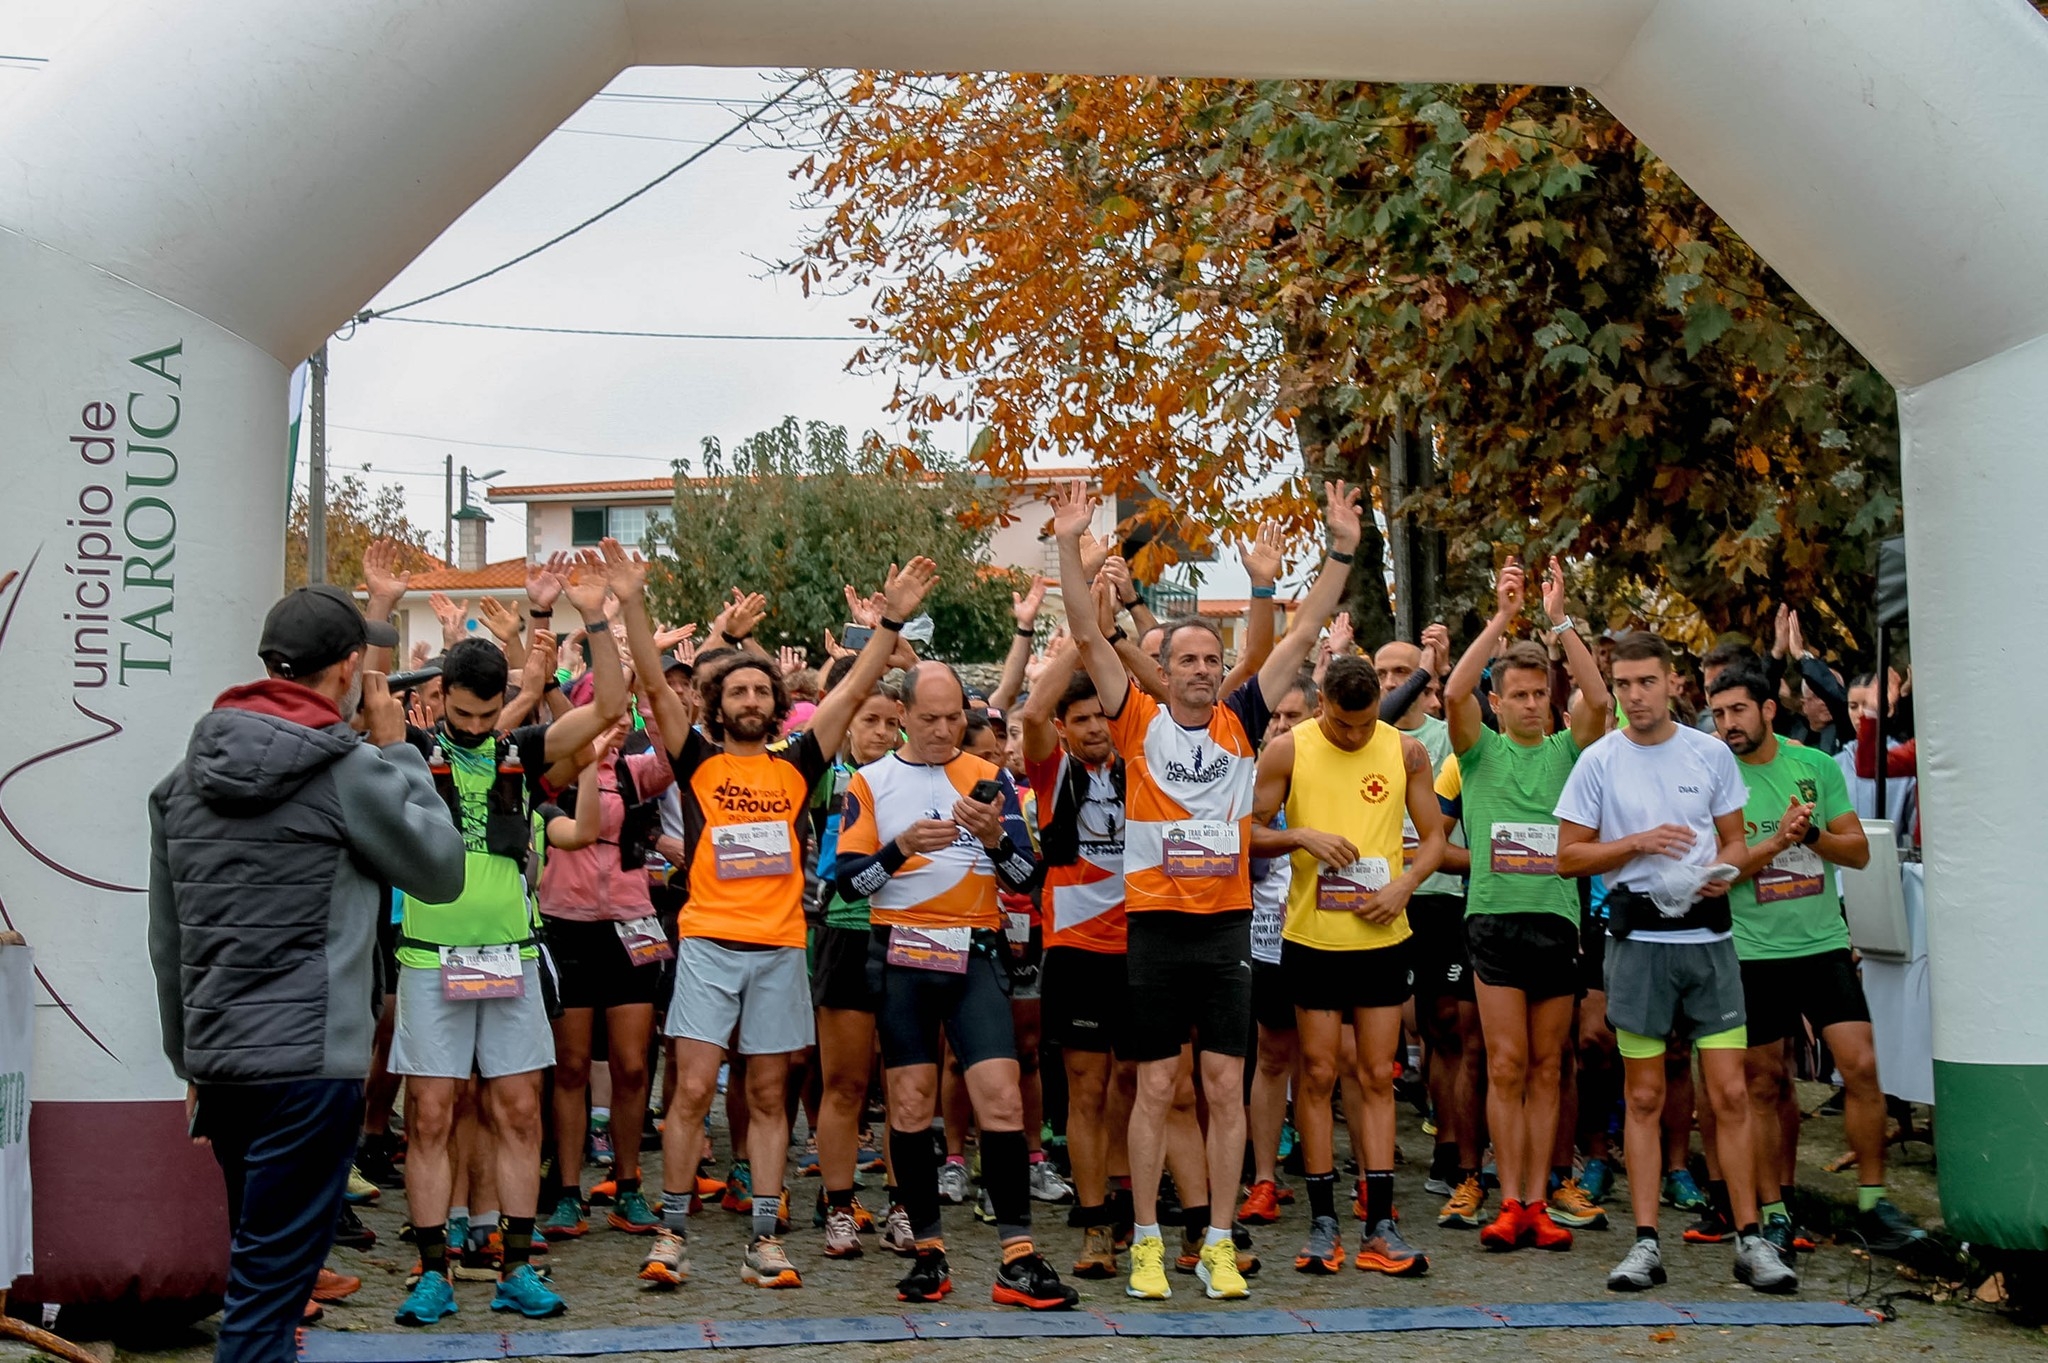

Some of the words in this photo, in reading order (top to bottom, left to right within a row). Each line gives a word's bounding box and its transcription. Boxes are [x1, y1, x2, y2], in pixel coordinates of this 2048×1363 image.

[69, 401, 117, 466] de
[118, 337, 184, 688] TAROUCA
[63, 484, 123, 689] unicípio
[713, 795, 792, 814] TAROUCA
